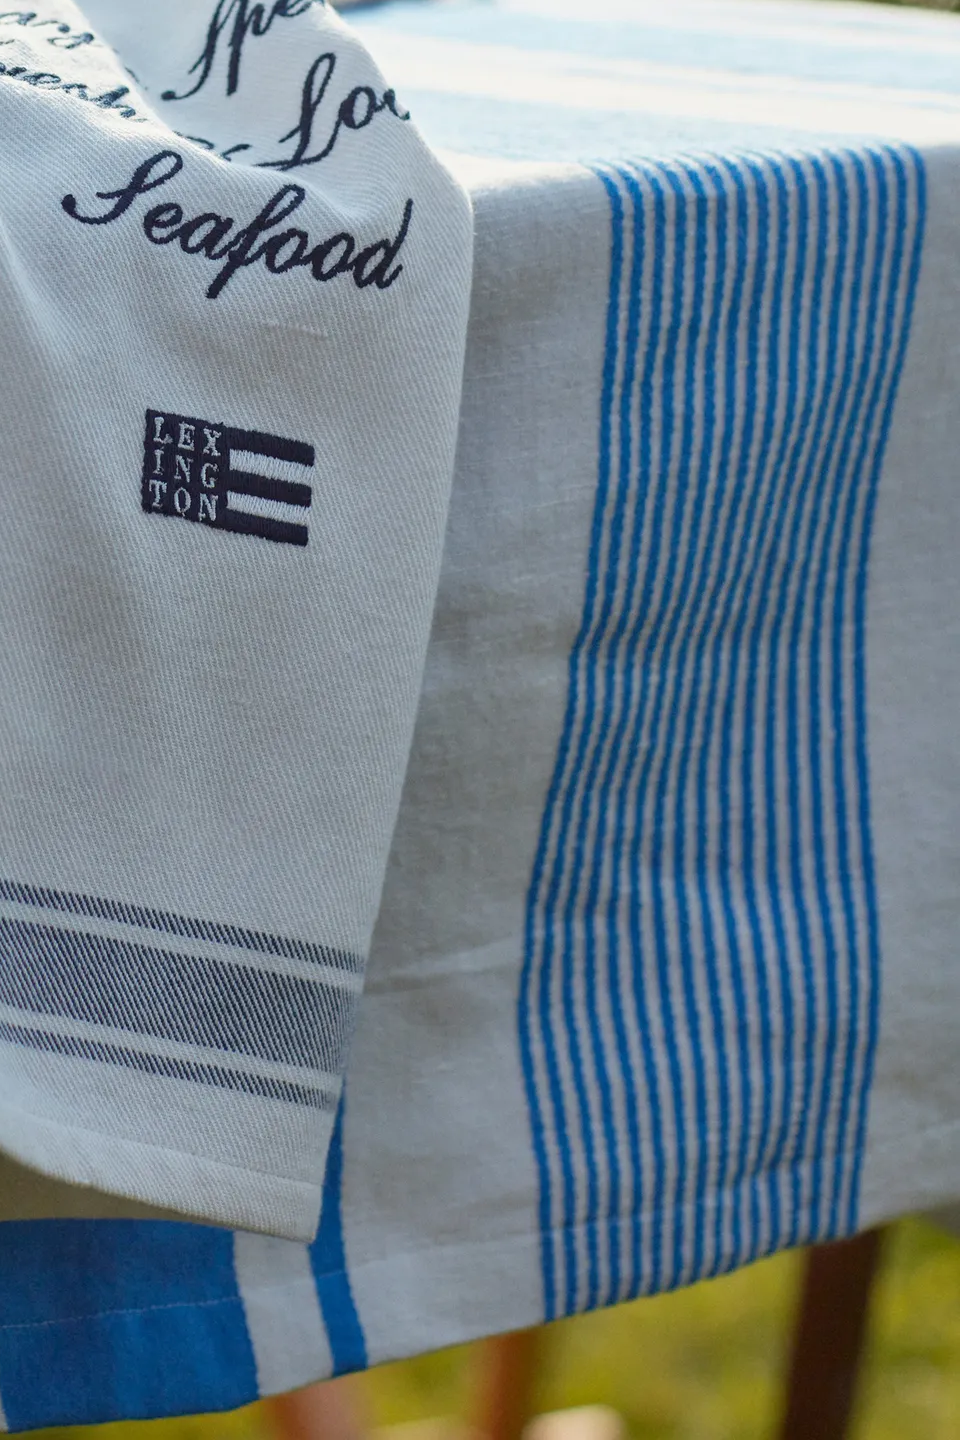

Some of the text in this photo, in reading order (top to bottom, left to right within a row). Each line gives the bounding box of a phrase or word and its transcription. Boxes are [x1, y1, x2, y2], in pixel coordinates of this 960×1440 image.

[60, 149, 414, 299] Seafood
[152, 416, 222, 457] LEX
[151, 446, 220, 489] ING
[147, 478, 219, 522] TON
